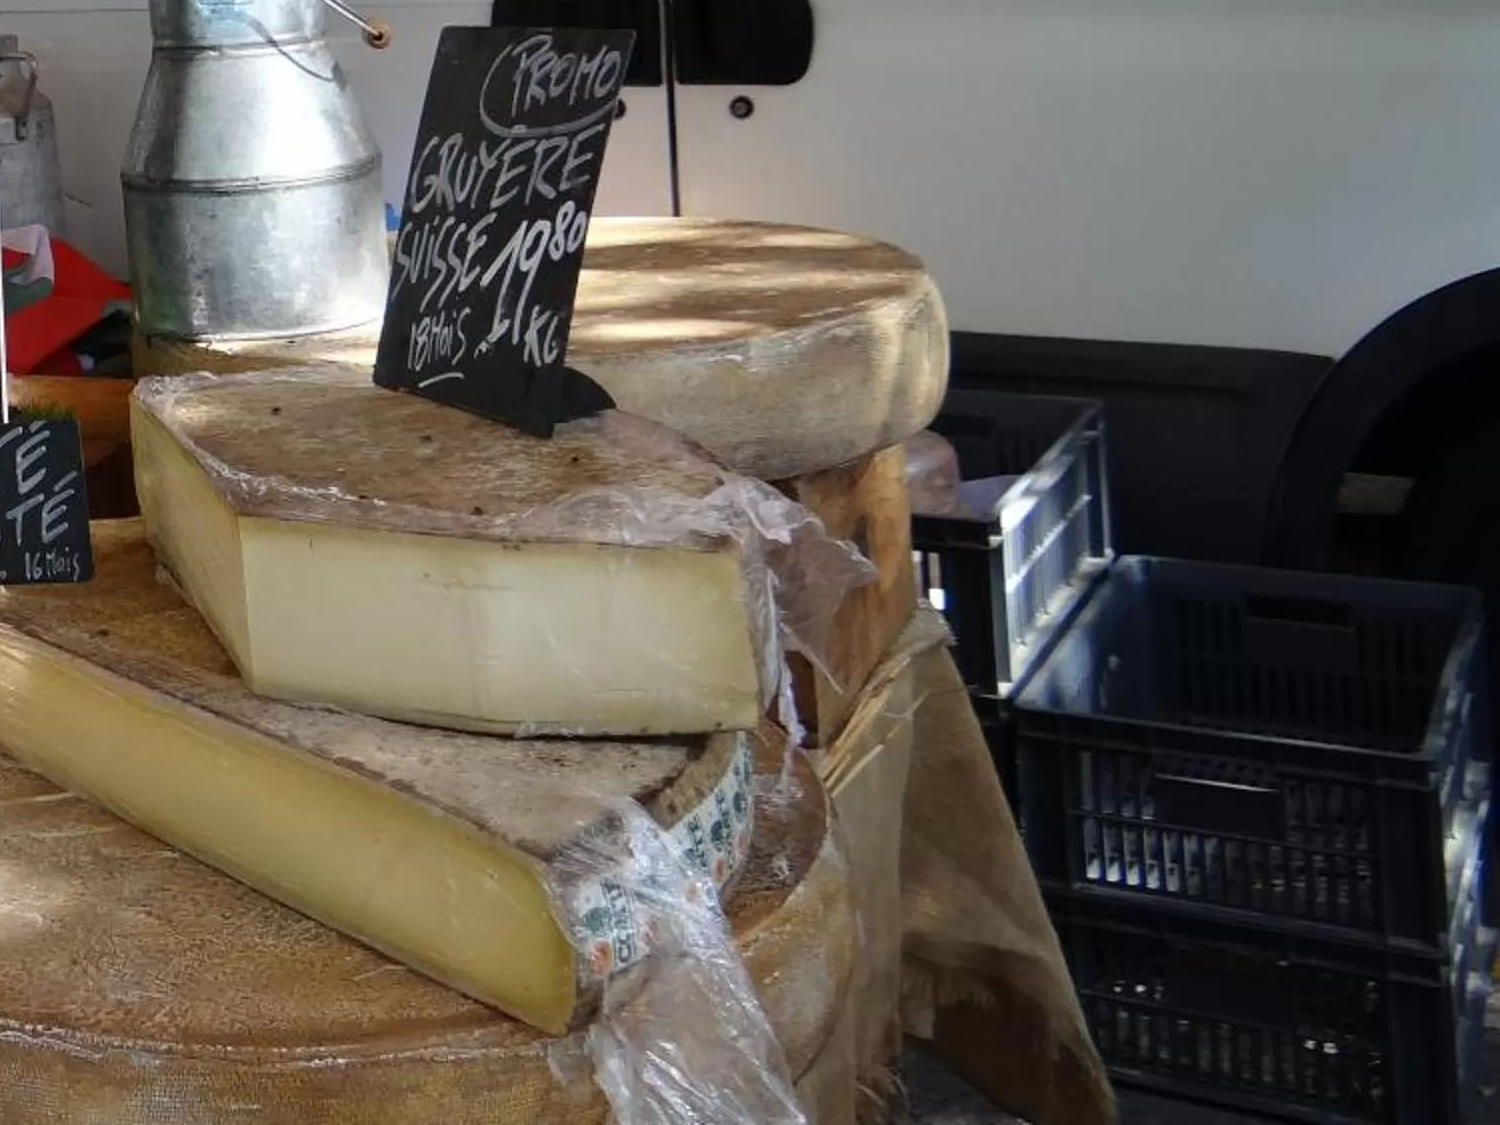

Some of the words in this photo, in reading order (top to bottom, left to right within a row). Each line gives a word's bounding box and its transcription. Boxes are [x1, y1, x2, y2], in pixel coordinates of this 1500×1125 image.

[510, 34, 621, 118] PROMO
[411, 124, 606, 214] GRUYERE
[523, 304, 560, 368] KG
[24, 552, 44, 580] 16
